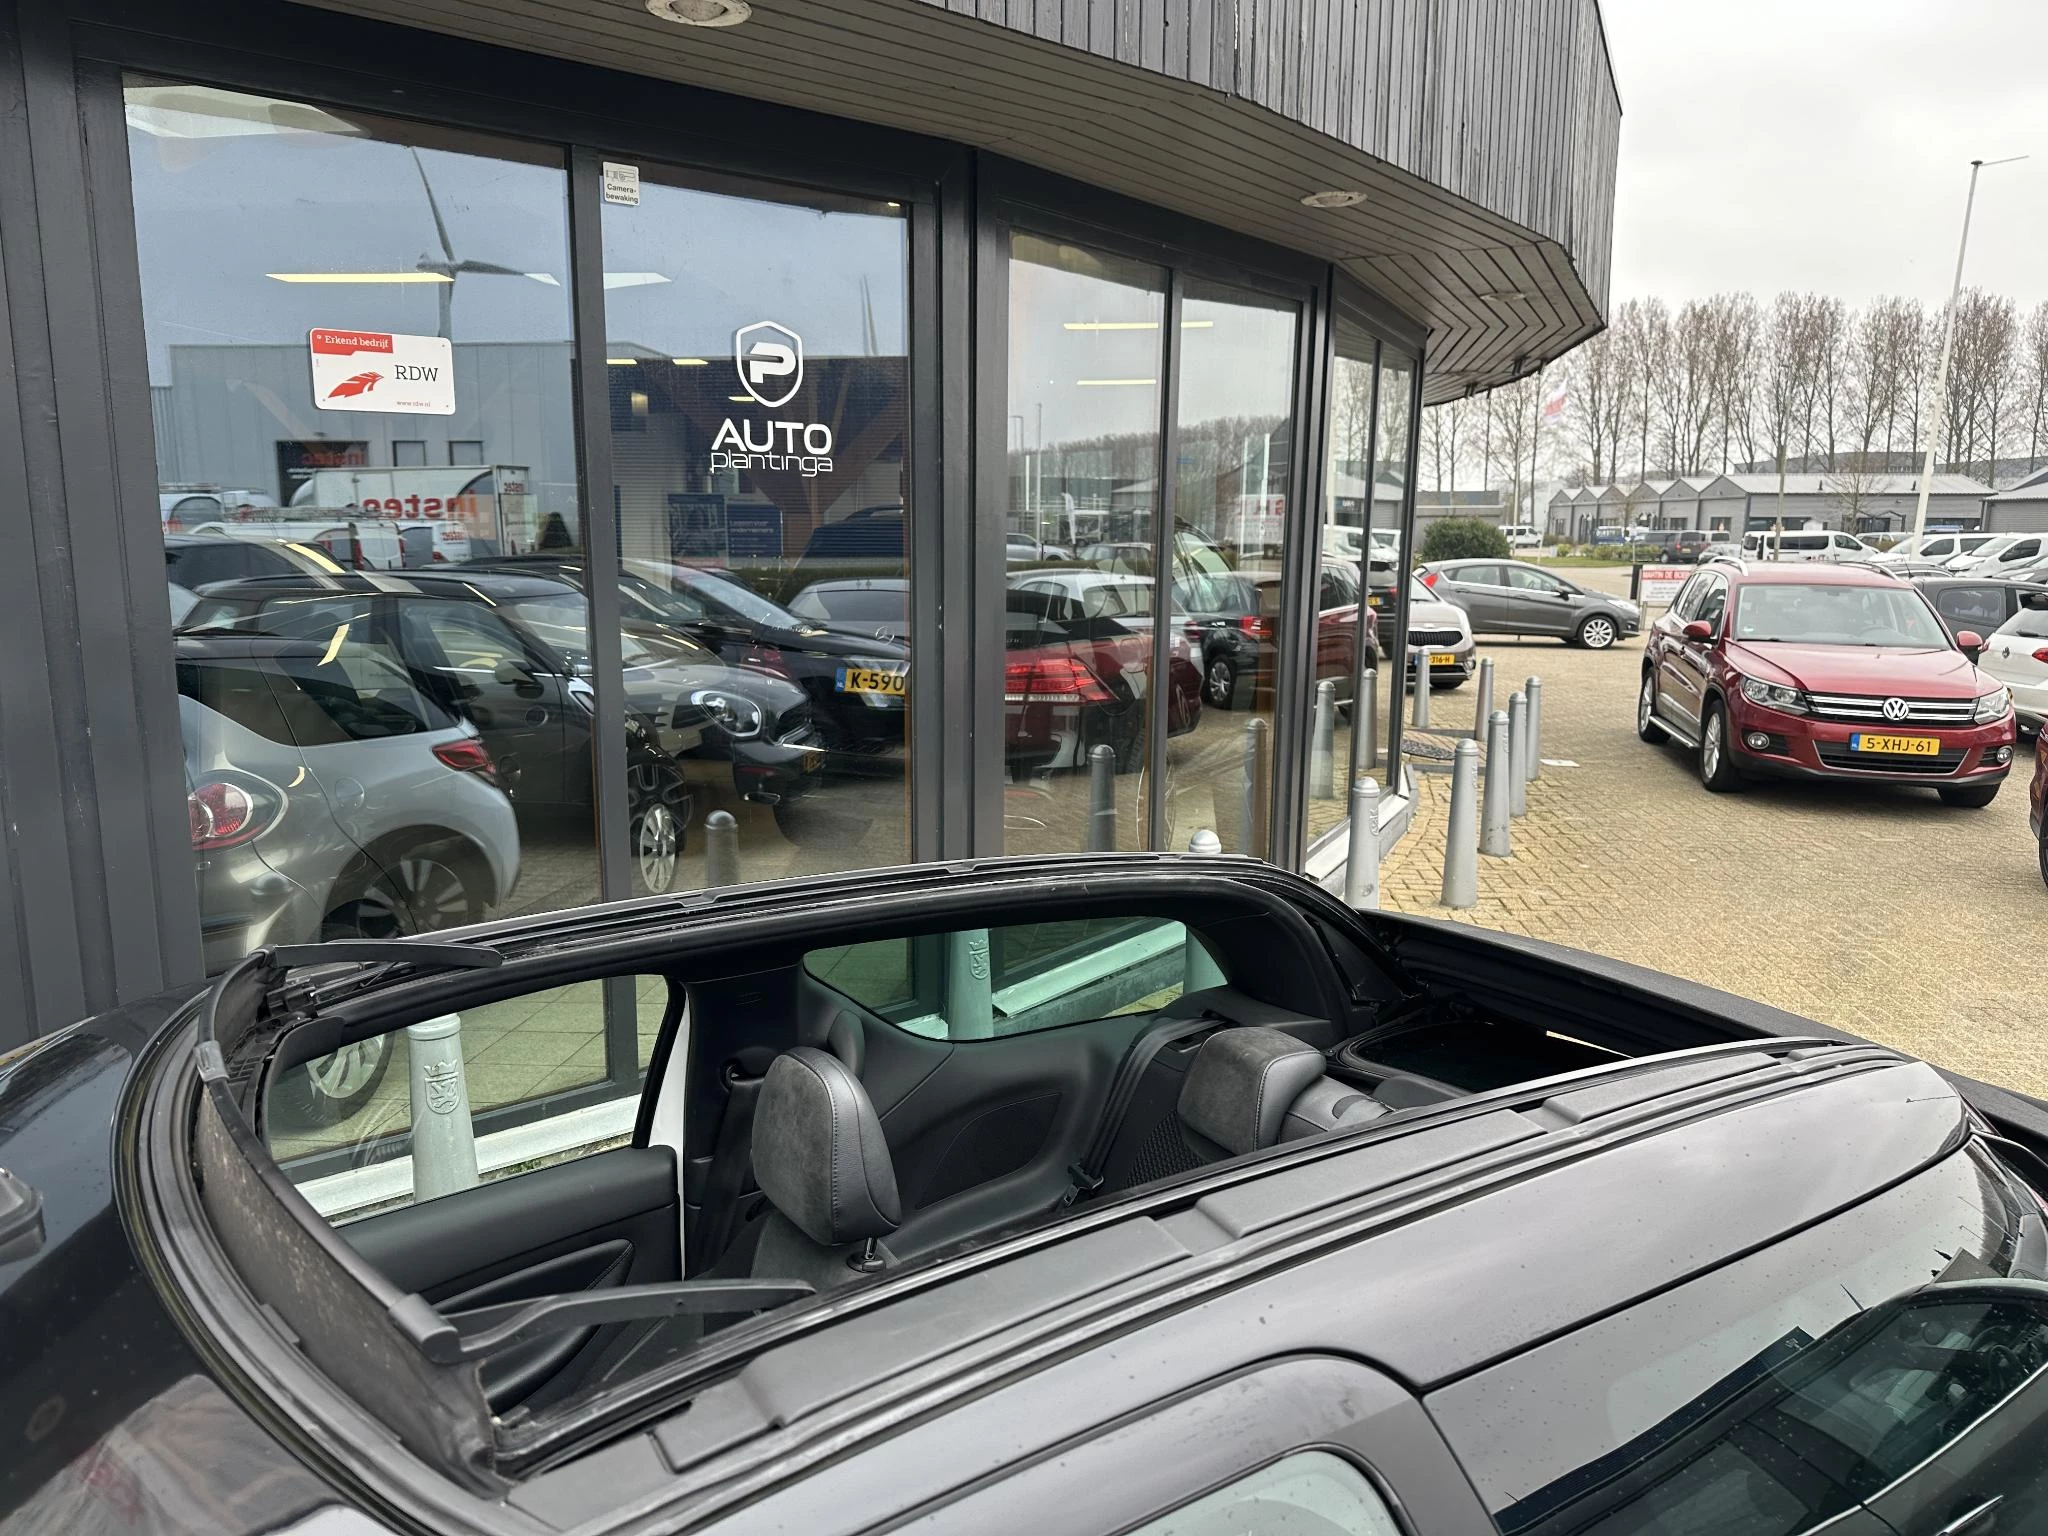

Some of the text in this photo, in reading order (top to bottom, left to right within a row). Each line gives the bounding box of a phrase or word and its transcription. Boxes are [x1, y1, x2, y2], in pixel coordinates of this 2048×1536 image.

[607, 183, 637, 193] Camera-
[605, 191, 639, 204] bewaking
[325, 335, 389, 349] Erkend bedrijf
[394, 364, 439, 382] RDW
[711, 418, 832, 455] AUTO
[709, 449, 833, 477] plantinga
[850, 672, 905, 691] K-590
[1866, 738, 1931, 752] 5-XHJ-61
